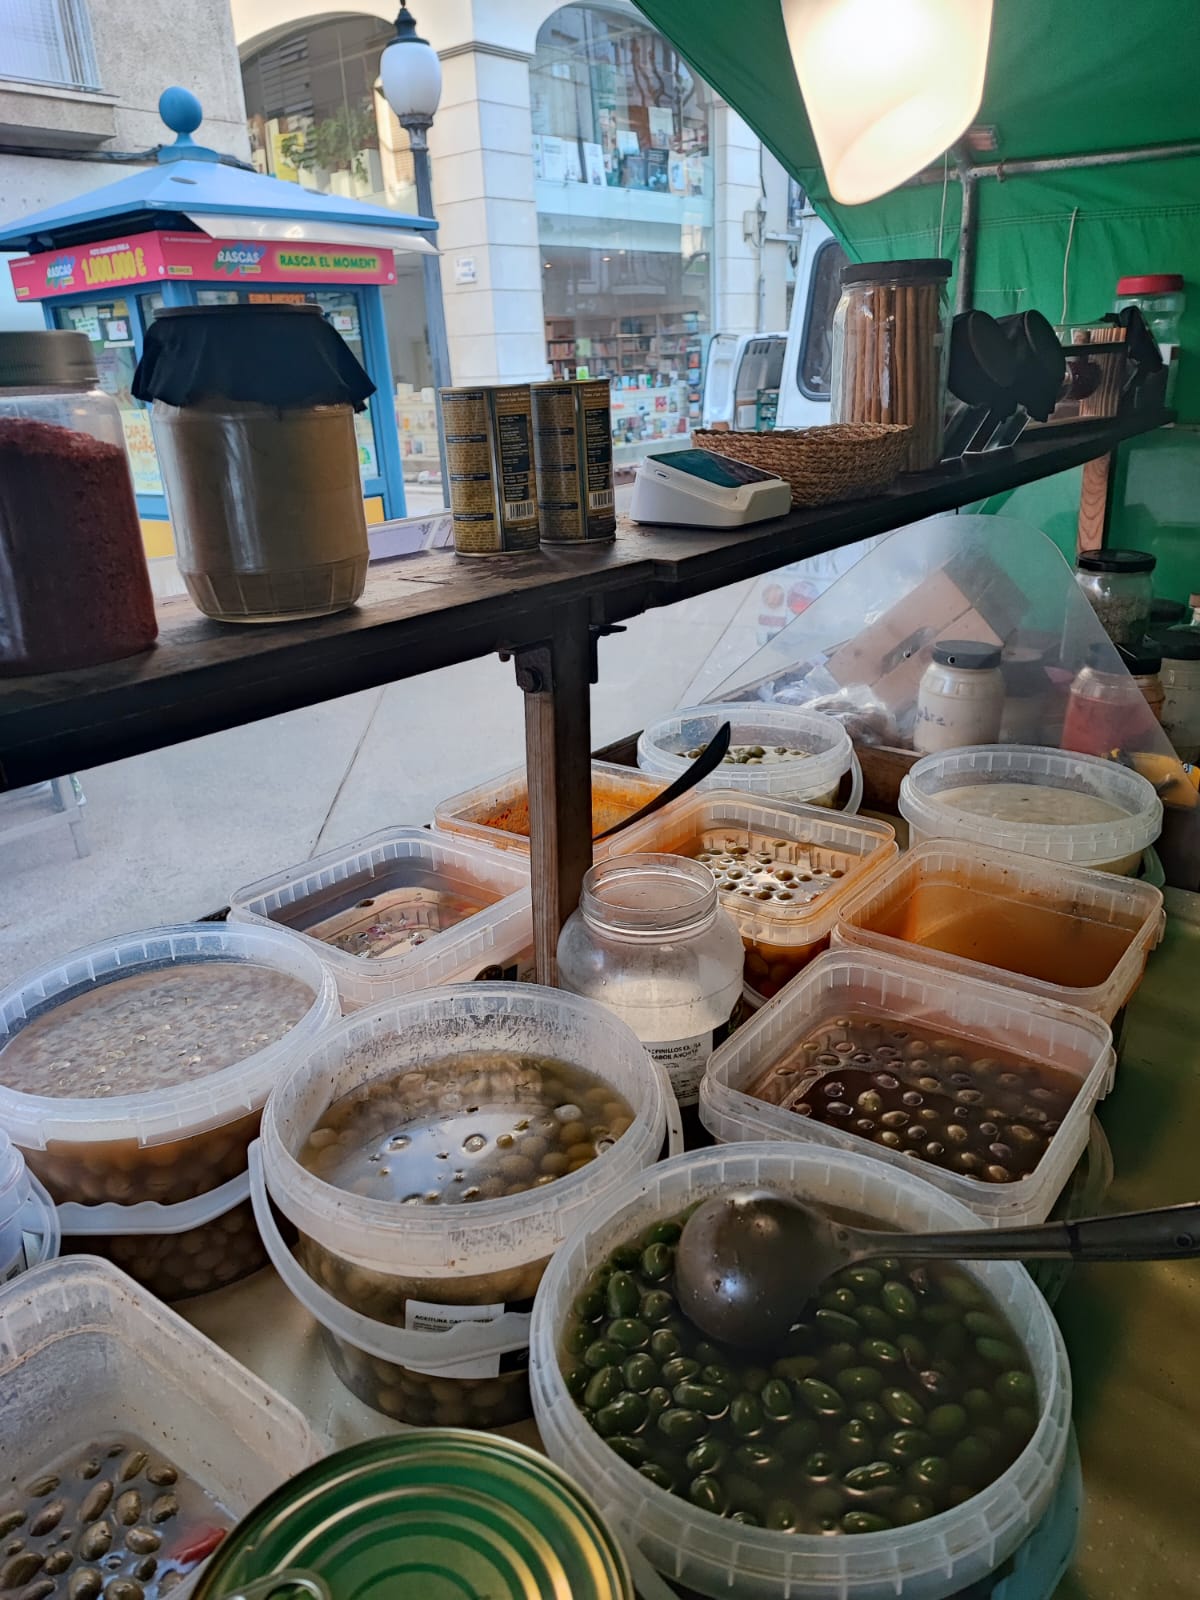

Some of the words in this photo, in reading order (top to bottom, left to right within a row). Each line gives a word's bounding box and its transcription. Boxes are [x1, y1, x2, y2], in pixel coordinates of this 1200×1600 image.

[217, 250, 260, 263] RASCAS
[280, 255, 317, 267] RASCA
[319, 256, 331, 268] EL
[333, 257, 377, 269] MOMENT
[46, 263, 73, 278] RASCAS
